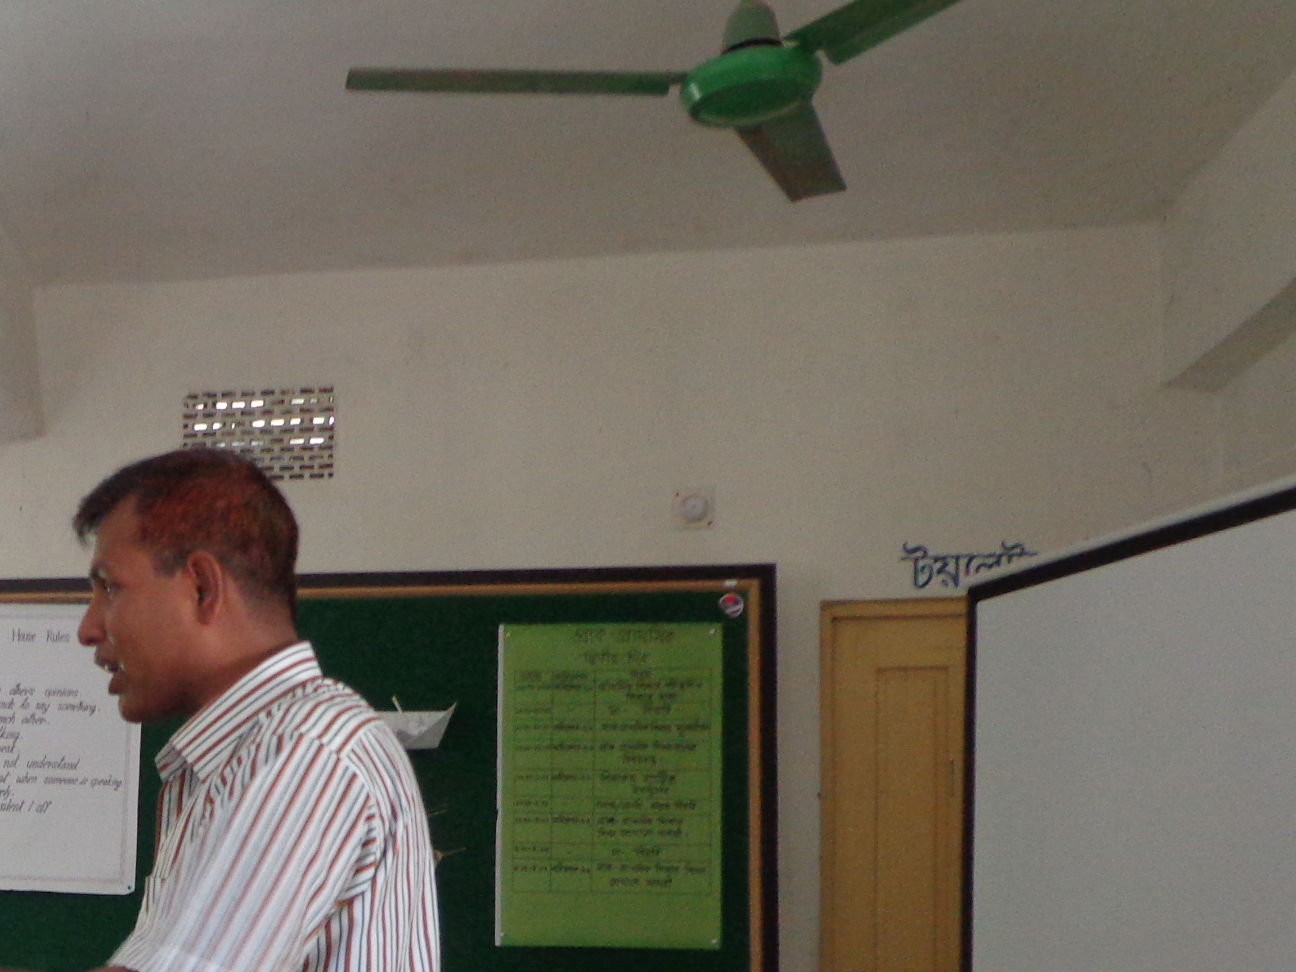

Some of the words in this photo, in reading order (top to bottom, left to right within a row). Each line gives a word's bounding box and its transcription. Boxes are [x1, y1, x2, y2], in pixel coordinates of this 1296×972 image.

[12, 628, 37, 643] House
[46, 629, 71, 643] Rules
[21, 697, 30, 711] to
[35, 701, 51, 715] say
[3, 754, 20, 769] not
[15, 770, 38, 784] when
[43, 776, 79, 787] someone
[35, 800, 52, 814] off
